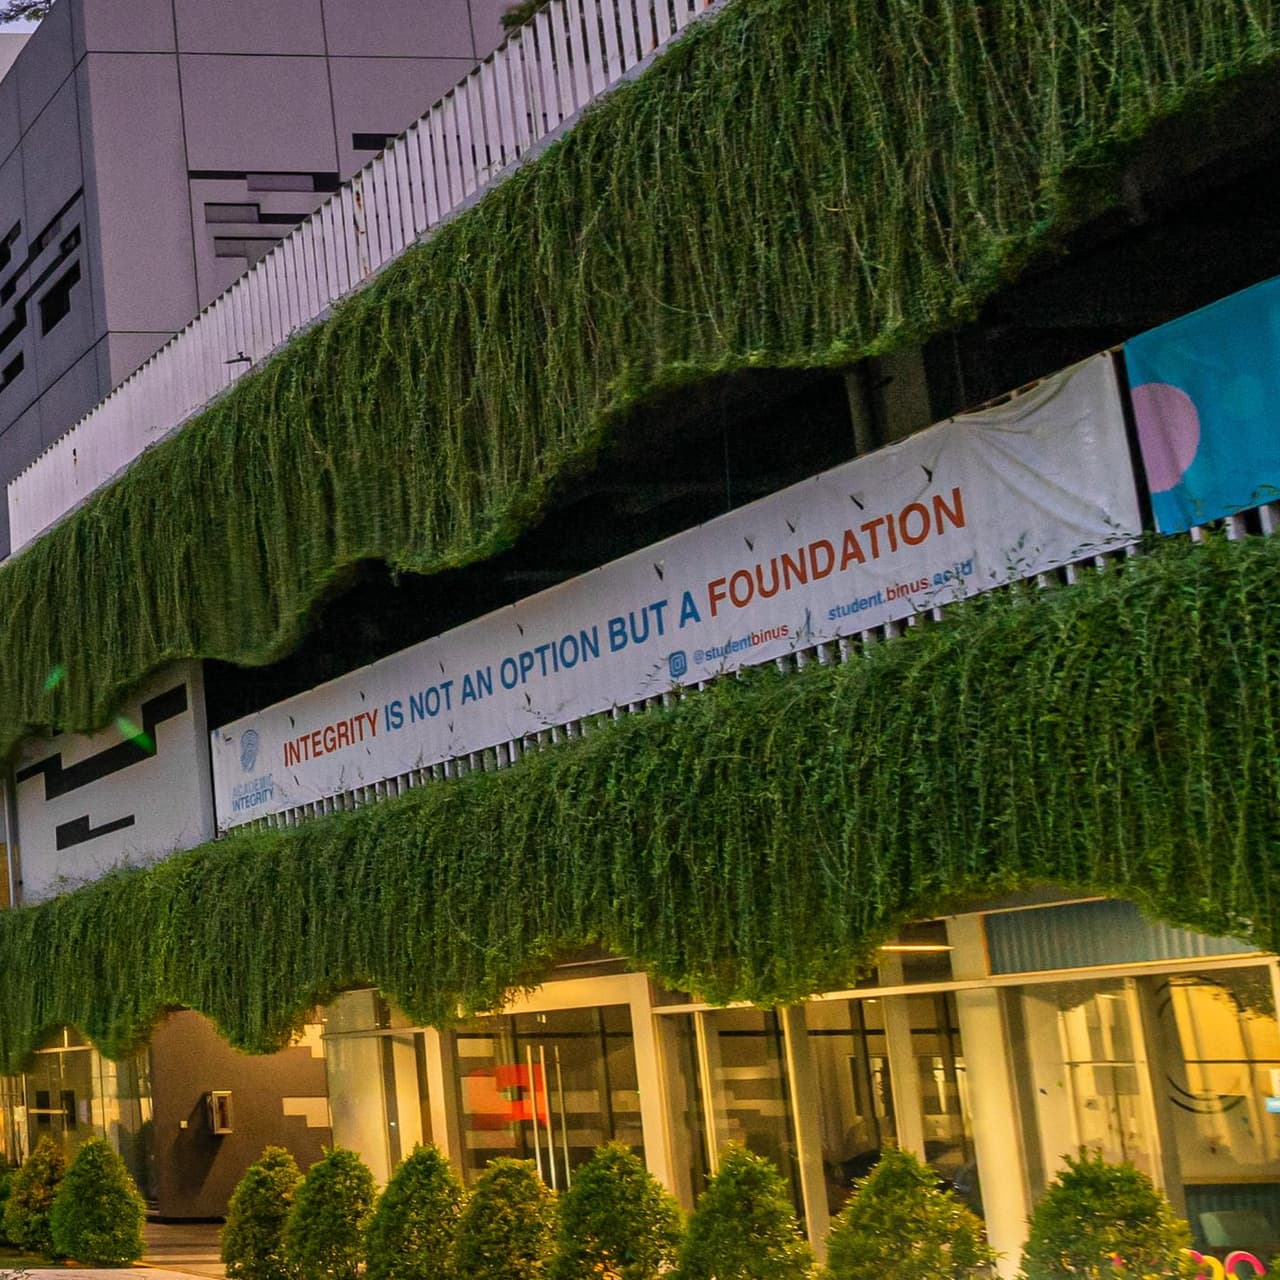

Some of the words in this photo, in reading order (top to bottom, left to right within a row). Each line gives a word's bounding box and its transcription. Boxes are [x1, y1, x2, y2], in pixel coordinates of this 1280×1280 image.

[828, 558, 973, 620] student.binus.acid
[283, 708, 378, 767] INTEGRITY
[384, 700, 404, 732] IS
[409, 680, 453, 723] NOT
[461, 666, 491, 705] AN
[500, 626, 600, 690] OPTION
[608, 600, 667, 652] BUT
[679, 590, 701, 628] A
[708, 487, 965, 617] FOUNDATION
[694, 624, 789, 664] @studentbinus
[232, 787, 273, 812] INTEGRITY
